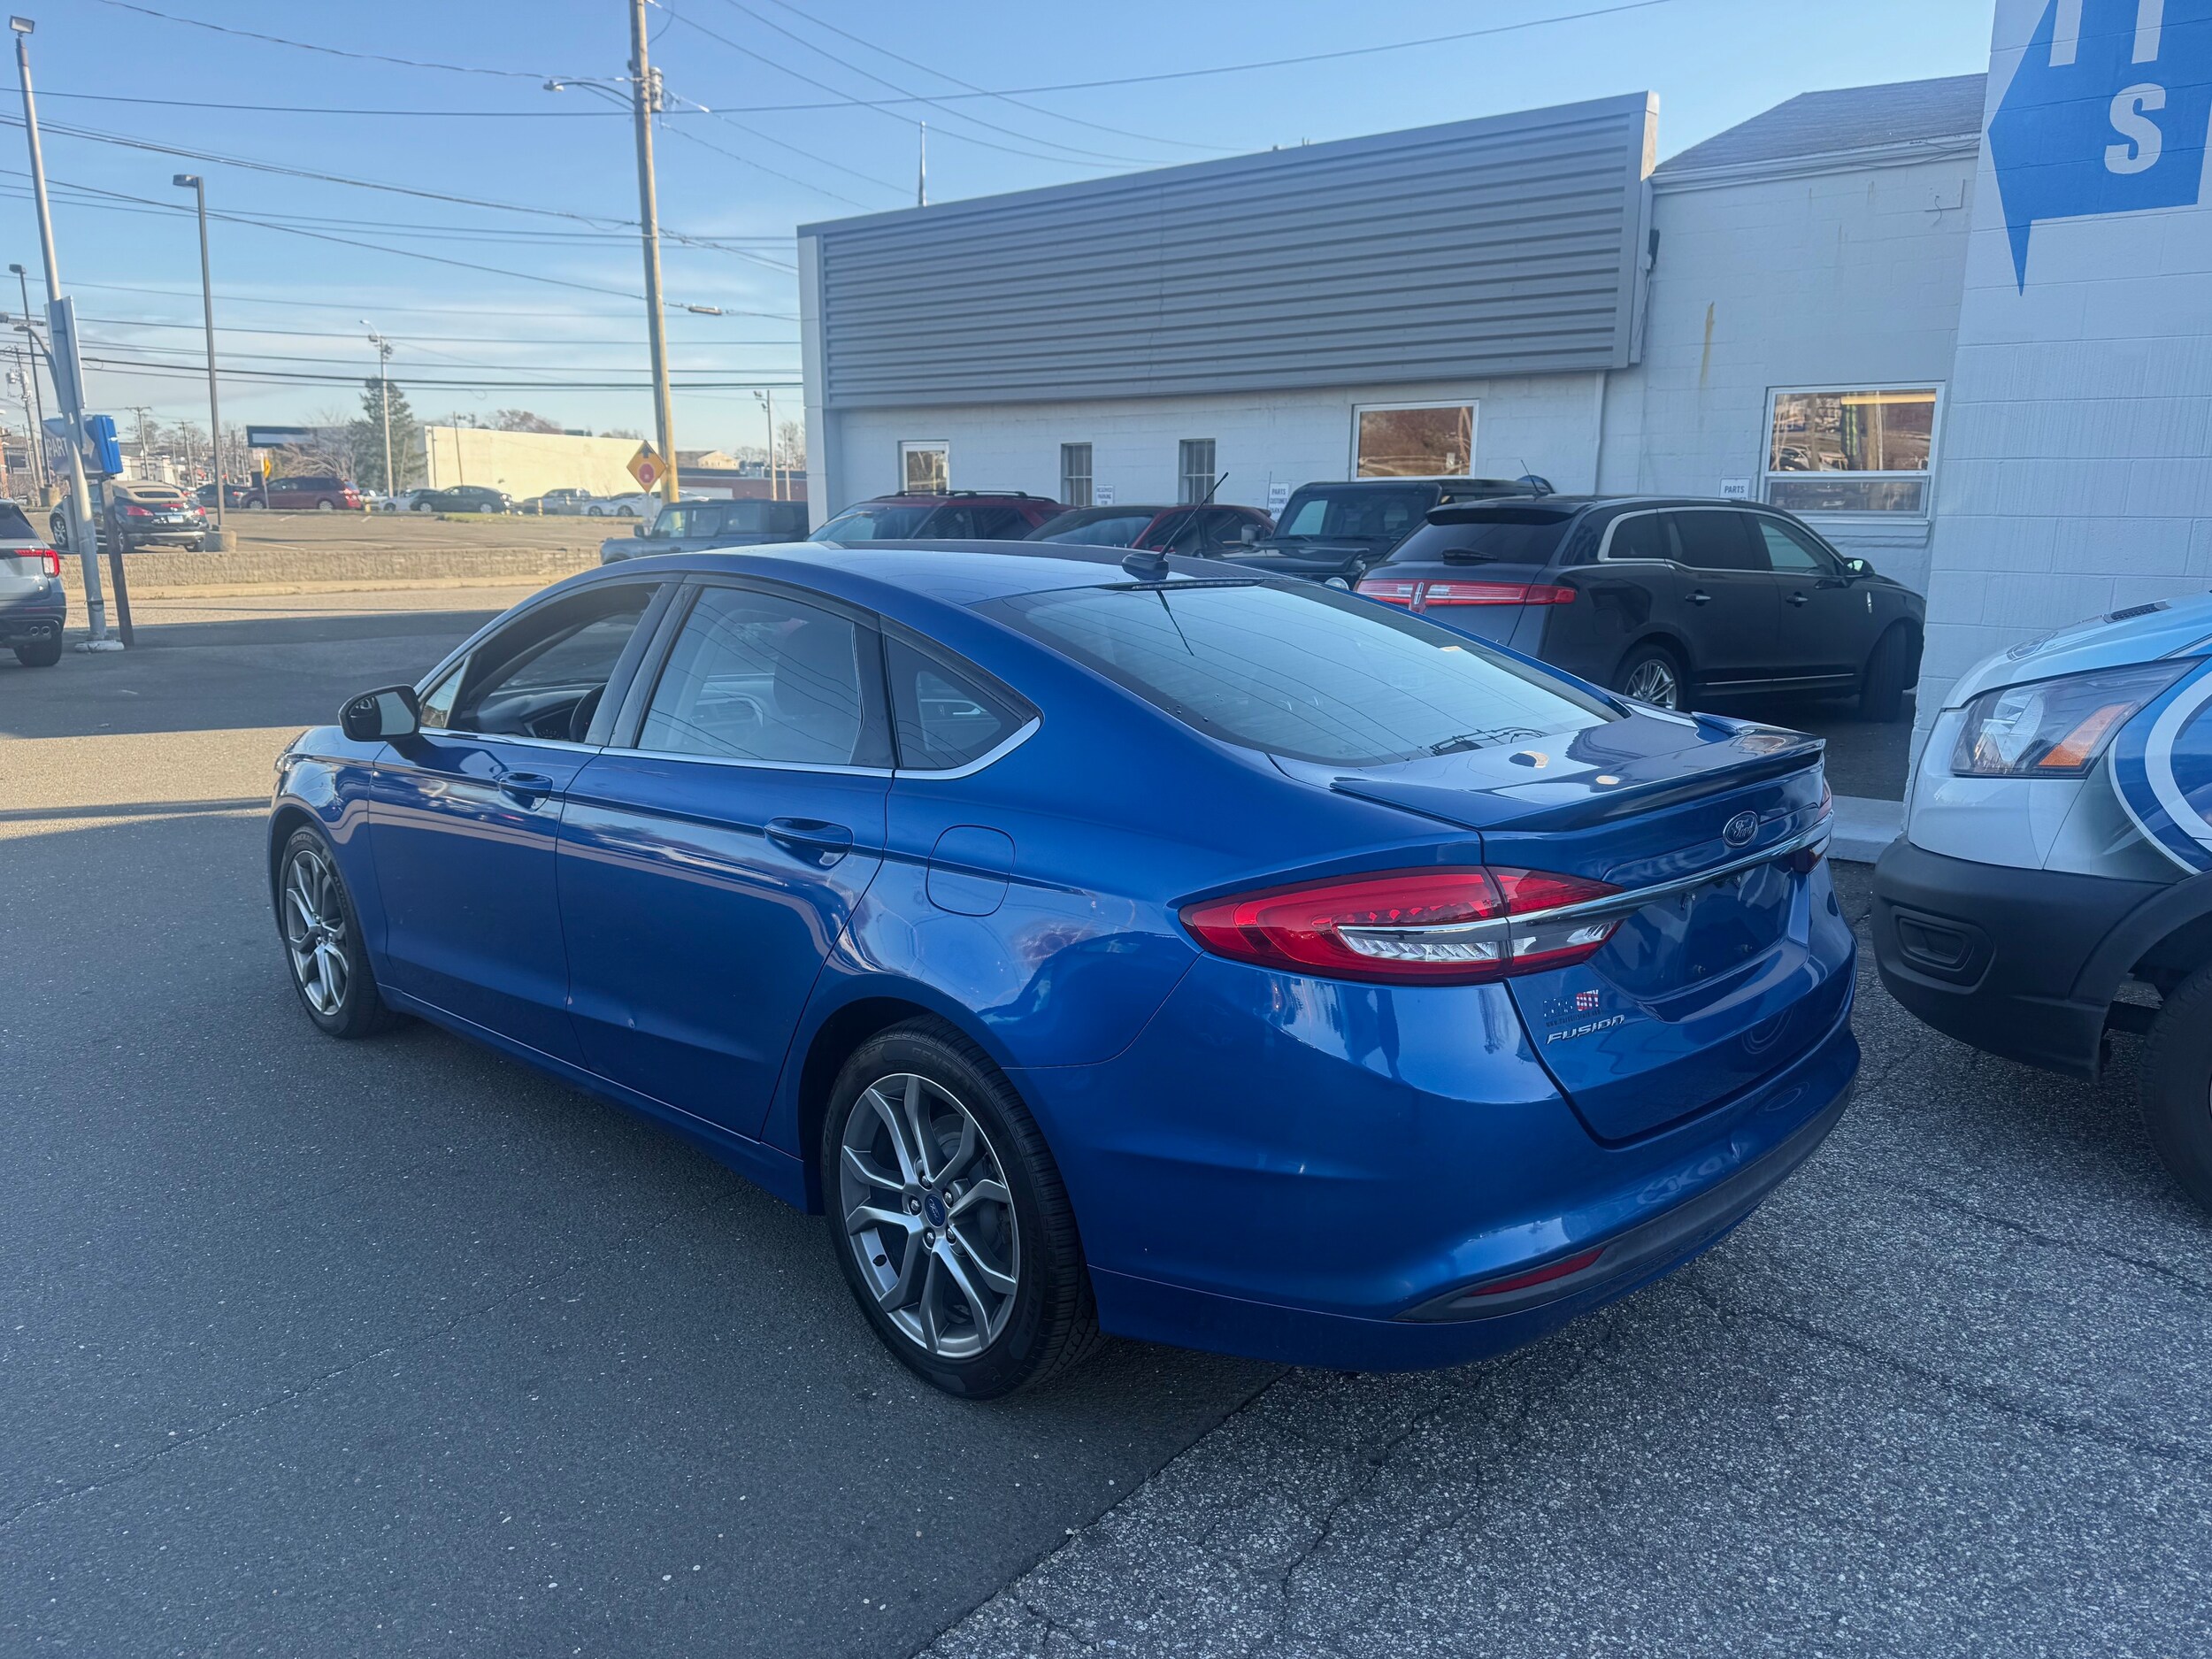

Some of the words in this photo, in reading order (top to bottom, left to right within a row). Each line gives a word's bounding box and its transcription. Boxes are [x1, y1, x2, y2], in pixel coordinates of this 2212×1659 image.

[46, 437, 69, 457] PART
[1724, 485, 1746, 494] PARTS
[1546, 1014, 1625, 1045] FUSION
